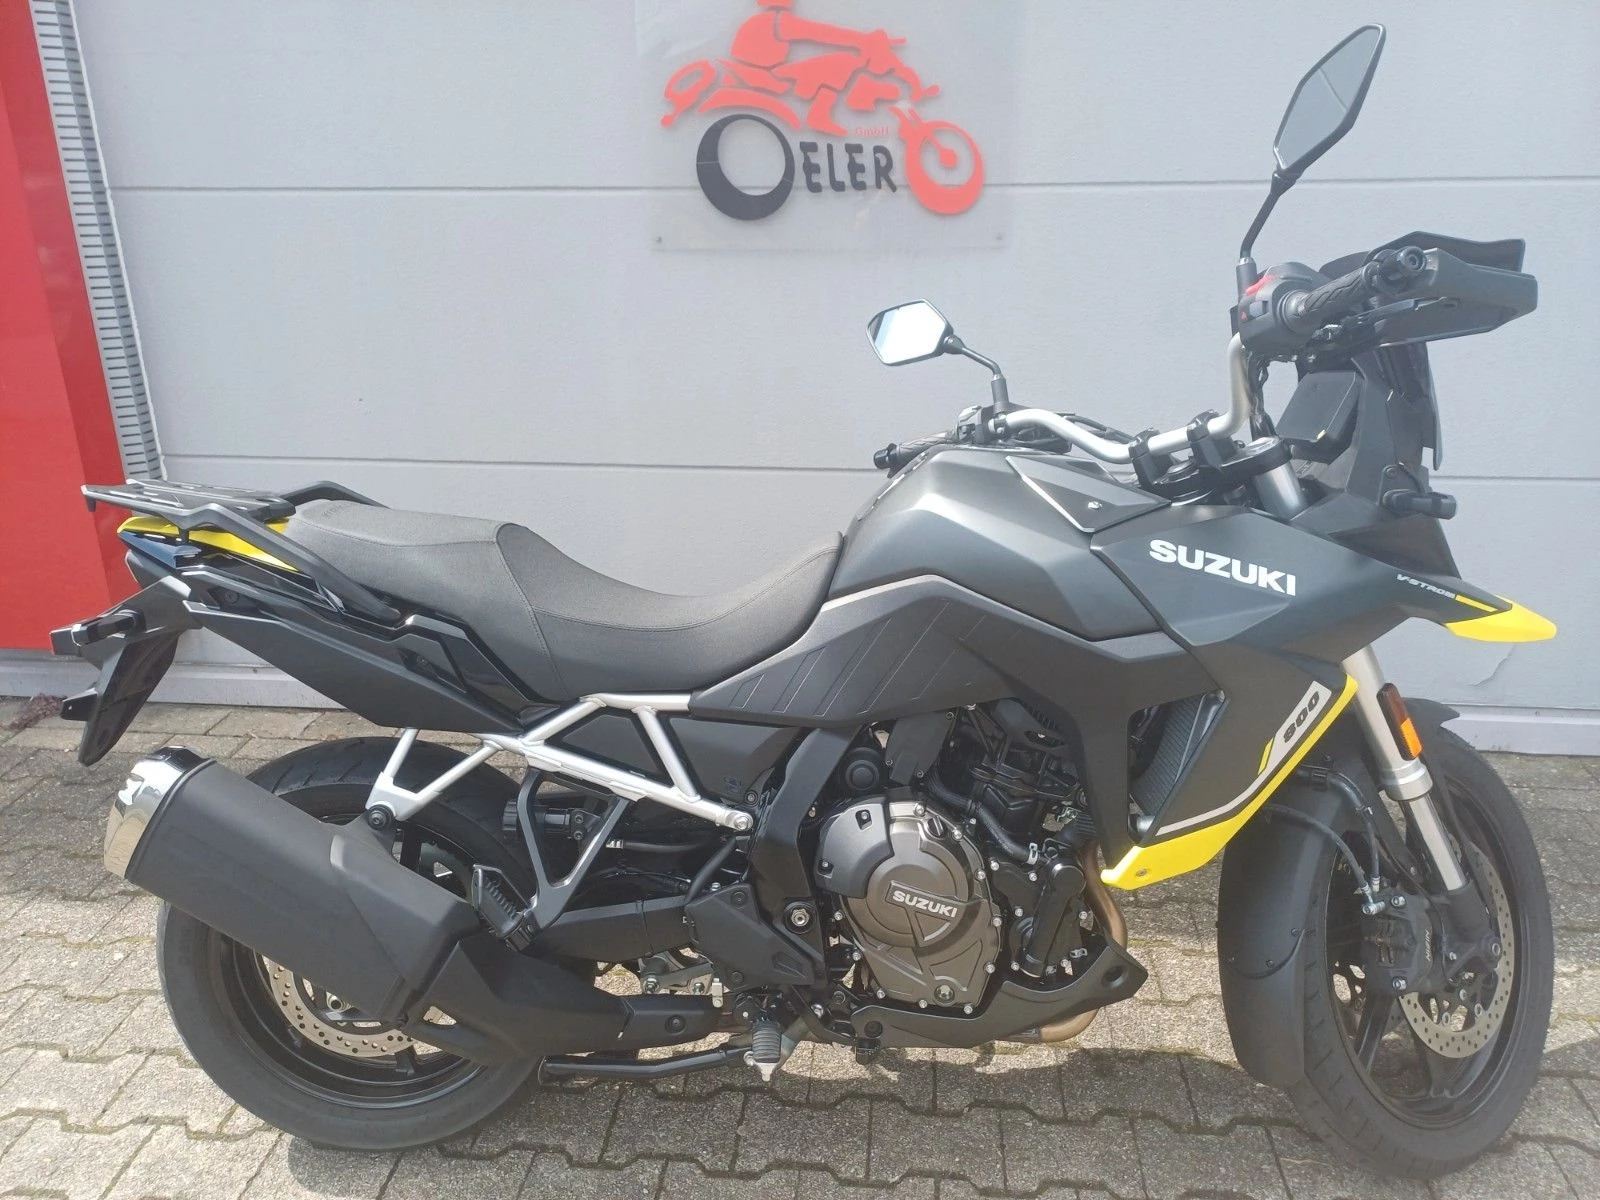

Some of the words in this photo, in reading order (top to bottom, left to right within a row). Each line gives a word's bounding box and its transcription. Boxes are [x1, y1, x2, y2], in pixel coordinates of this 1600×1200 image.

[1149, 539, 1296, 596] SUZUKI
[1397, 574, 1456, 599] V-STROM
[1283, 690, 1320, 743] 800
[892, 890, 958, 918] SUZUKI
